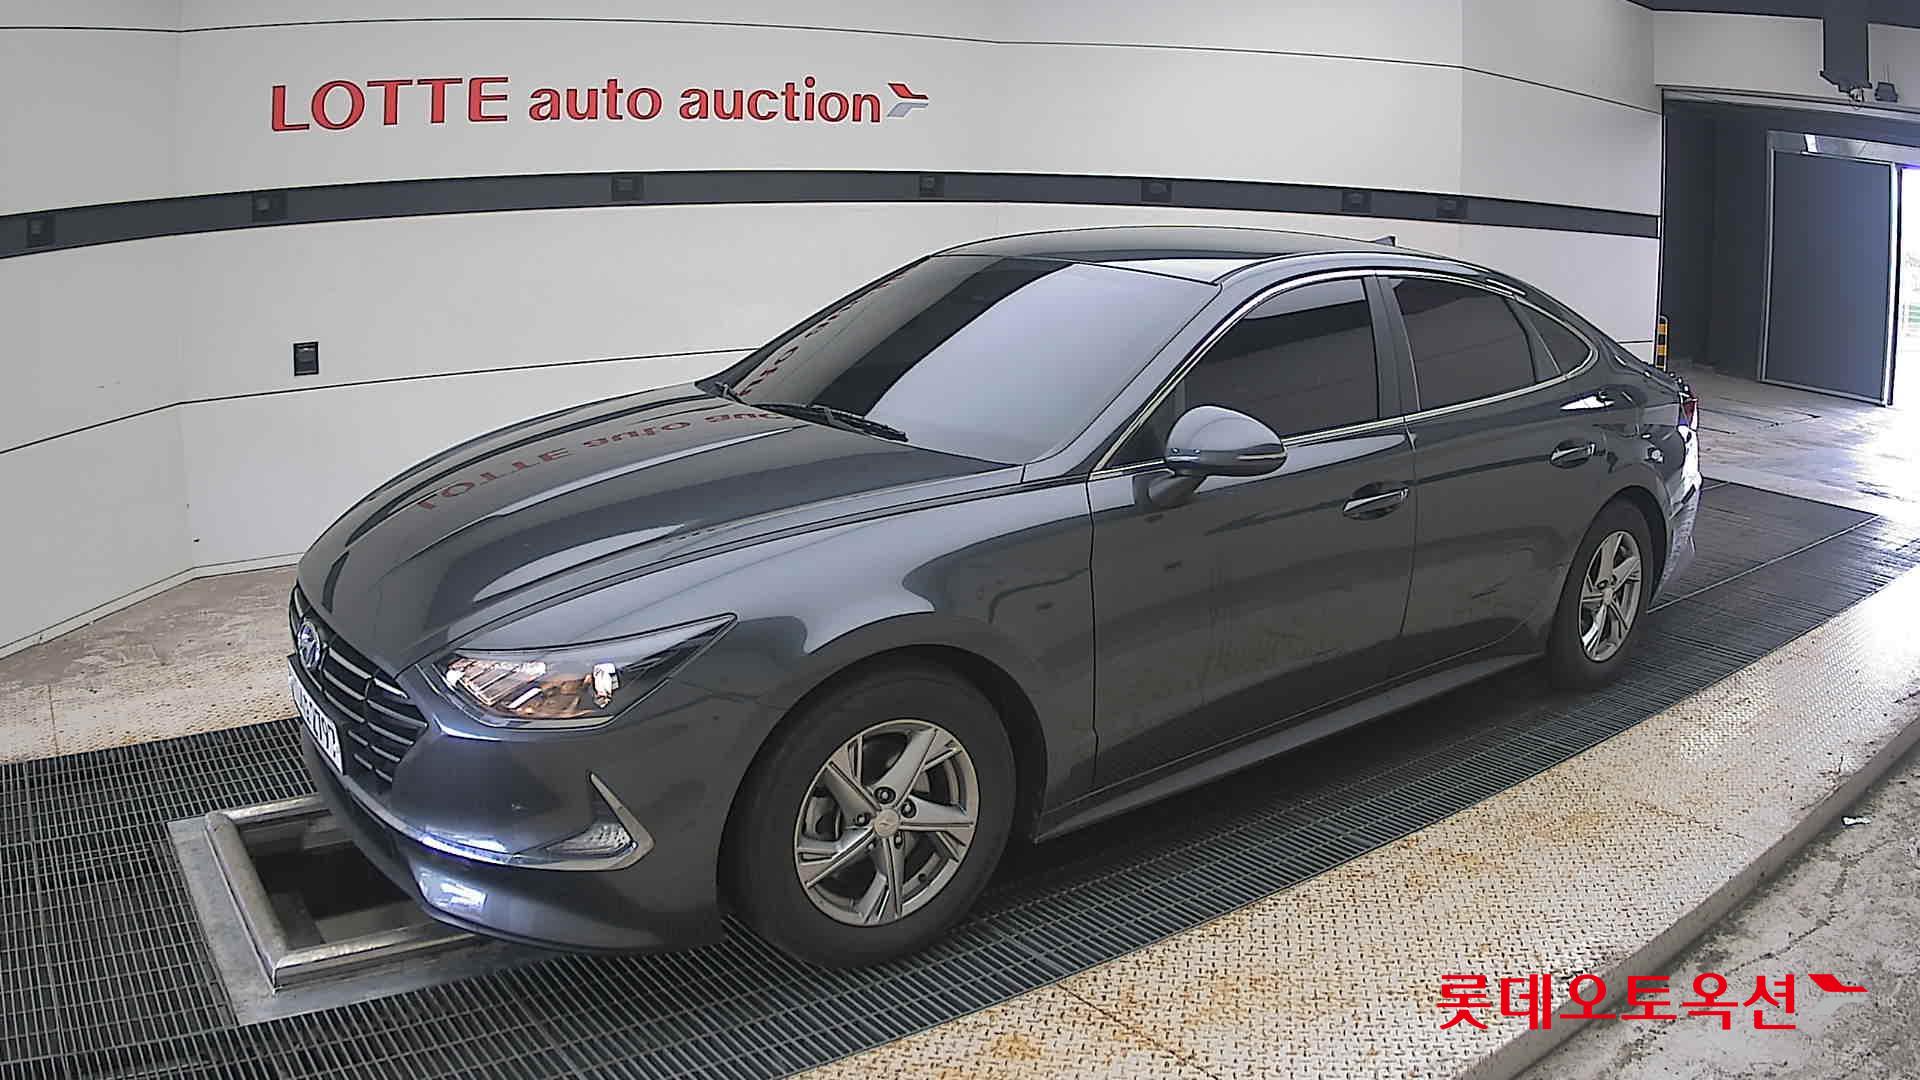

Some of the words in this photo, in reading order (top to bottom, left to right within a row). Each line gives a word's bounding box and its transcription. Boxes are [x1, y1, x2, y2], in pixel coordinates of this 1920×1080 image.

[270, 75, 510, 133] LOTTE
[527, 78, 664, 122] auto
[678, 76, 882, 123] auction
